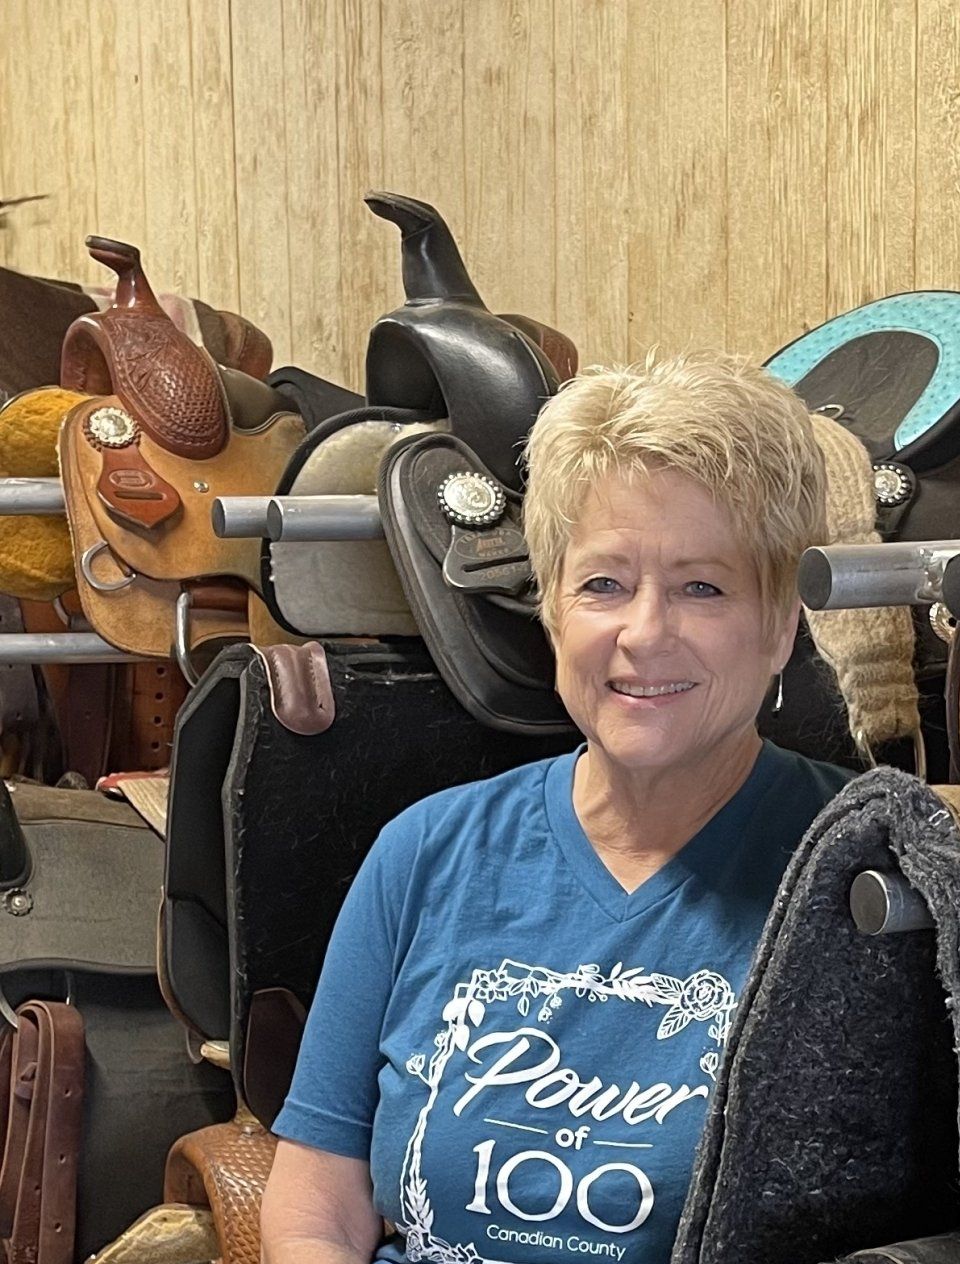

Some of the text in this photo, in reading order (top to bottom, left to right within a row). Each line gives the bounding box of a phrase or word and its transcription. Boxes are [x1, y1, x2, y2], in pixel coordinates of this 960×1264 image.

[453, 1027, 709, 1125] Power
[555, 1126, 590, 1150] of
[465, 1139, 654, 1234] 100
[486, 1224, 626, 1262] Canadian County
